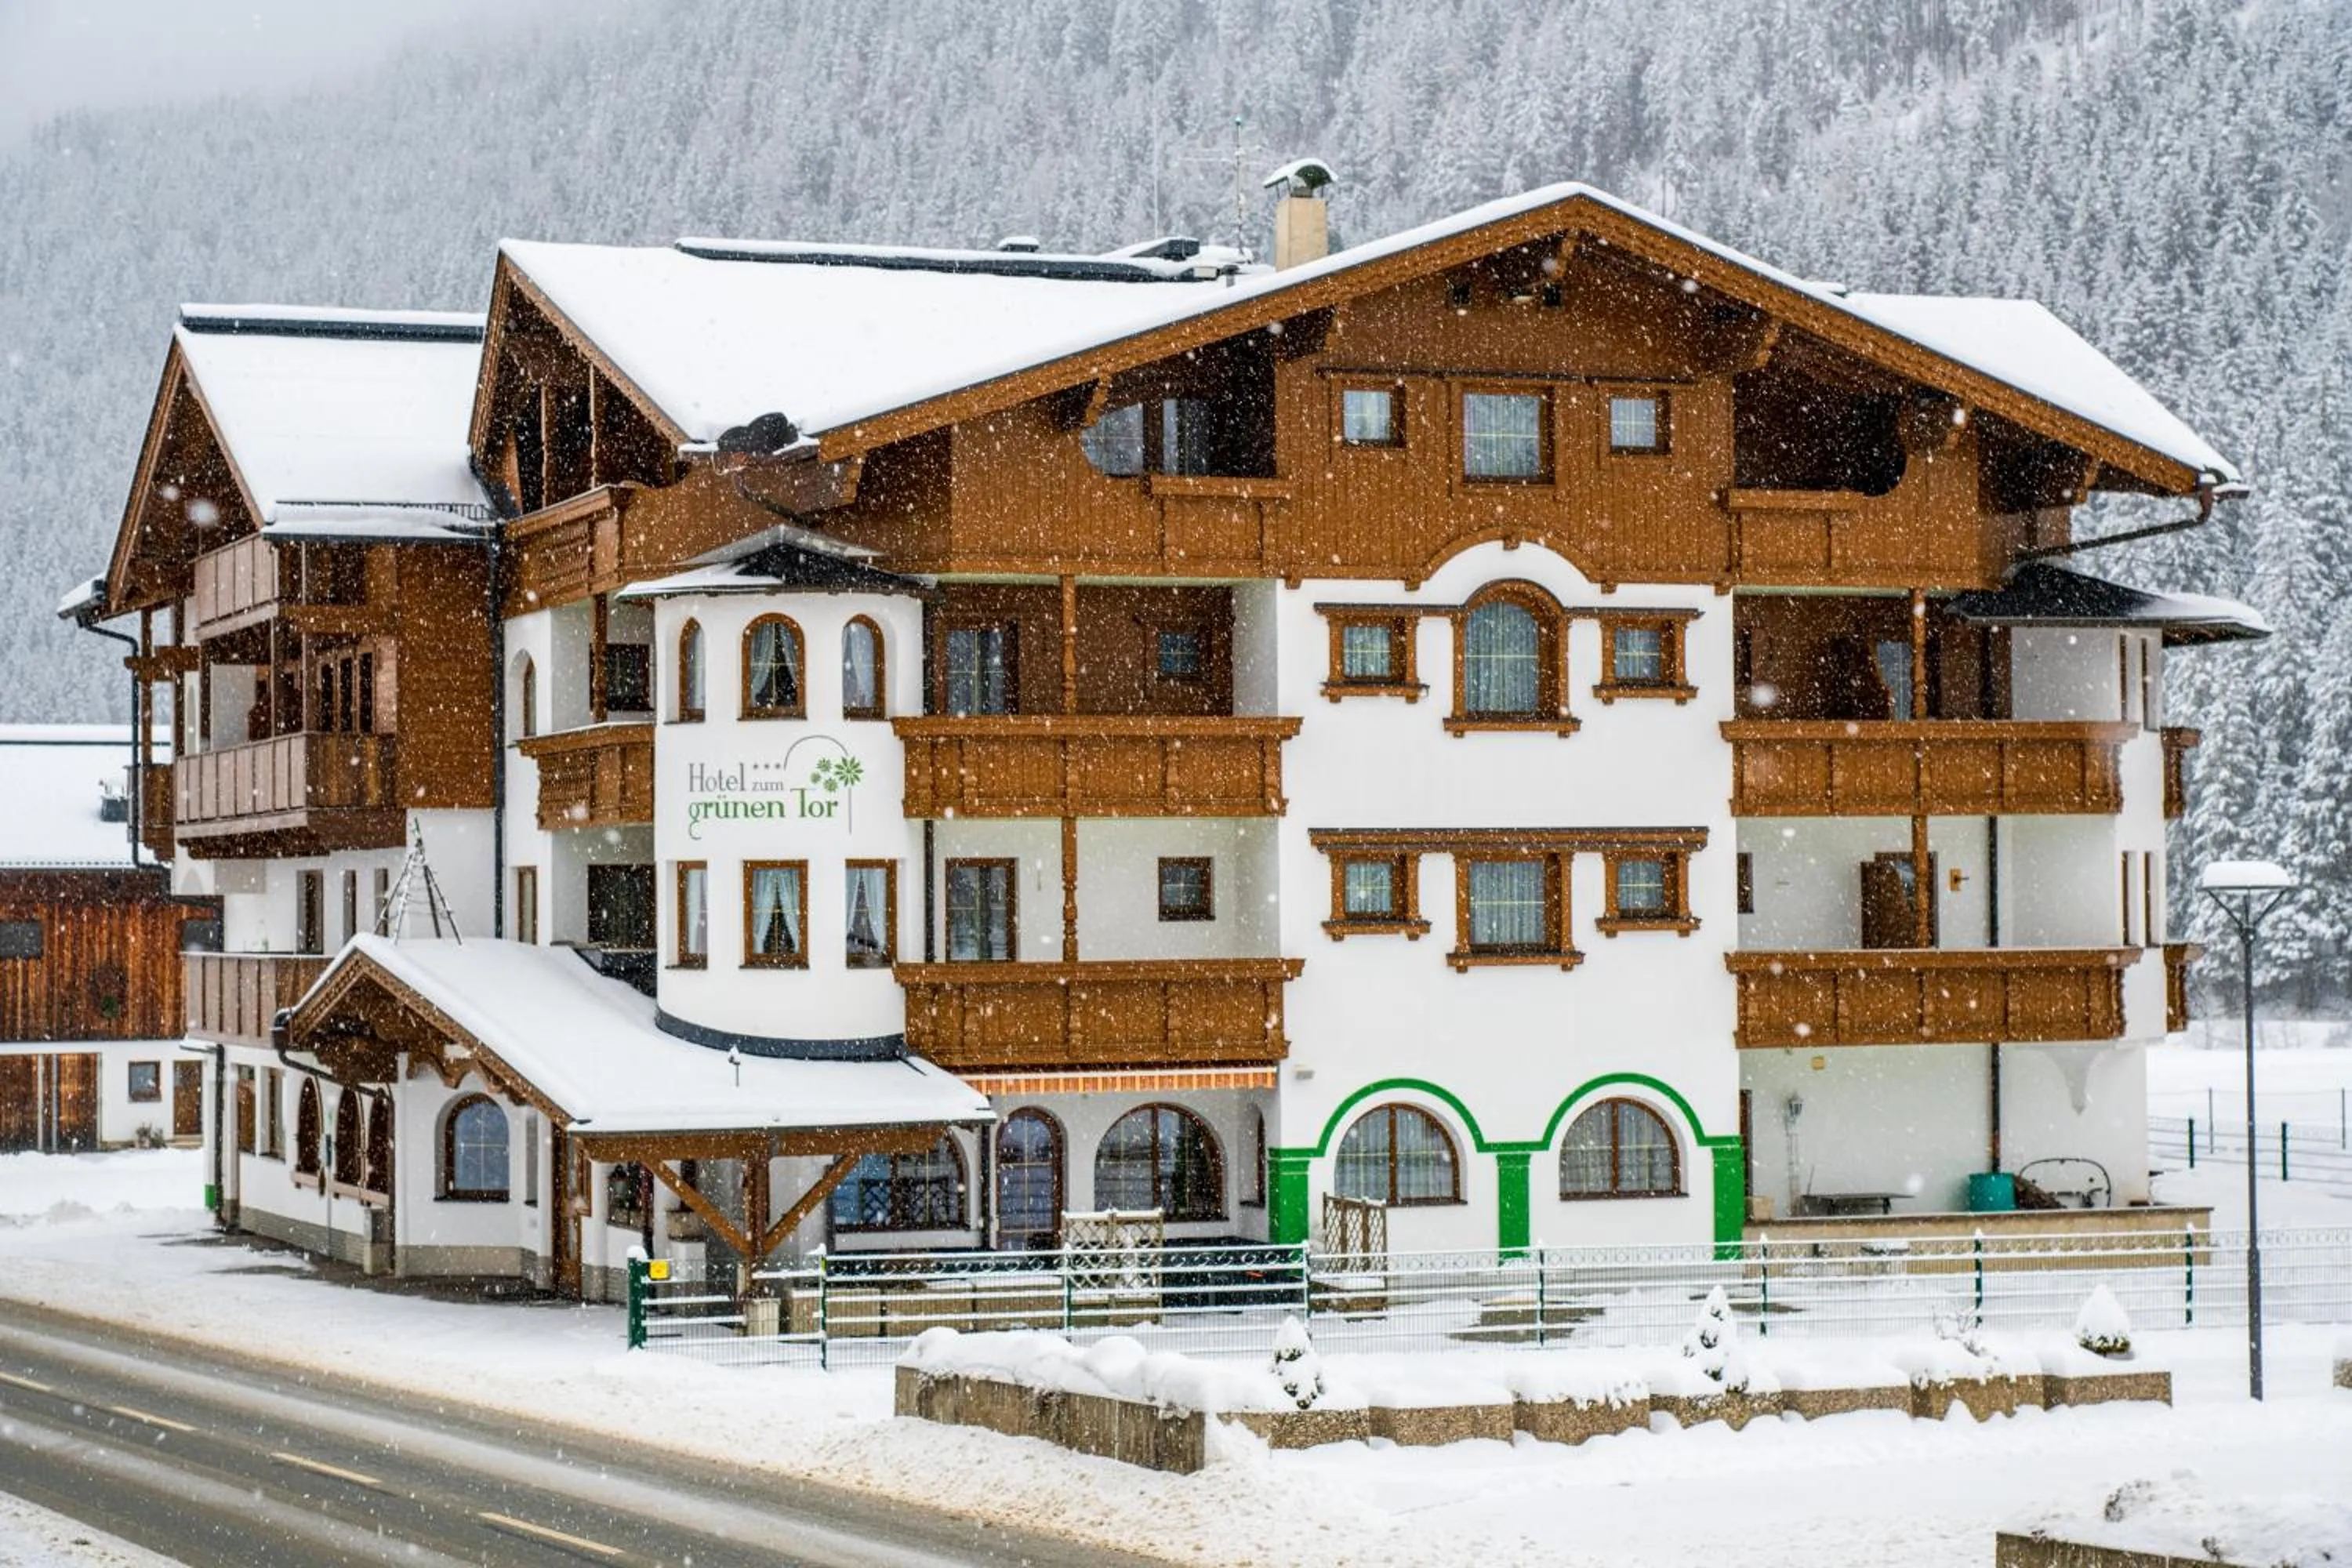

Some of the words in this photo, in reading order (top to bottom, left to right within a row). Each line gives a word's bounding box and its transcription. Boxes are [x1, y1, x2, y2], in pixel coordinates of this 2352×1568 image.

[688, 763, 746, 792] Hotel
[751, 780, 784, 792] zum
[688, 794, 786, 840] grünen
[790, 788, 839, 818] Tor
